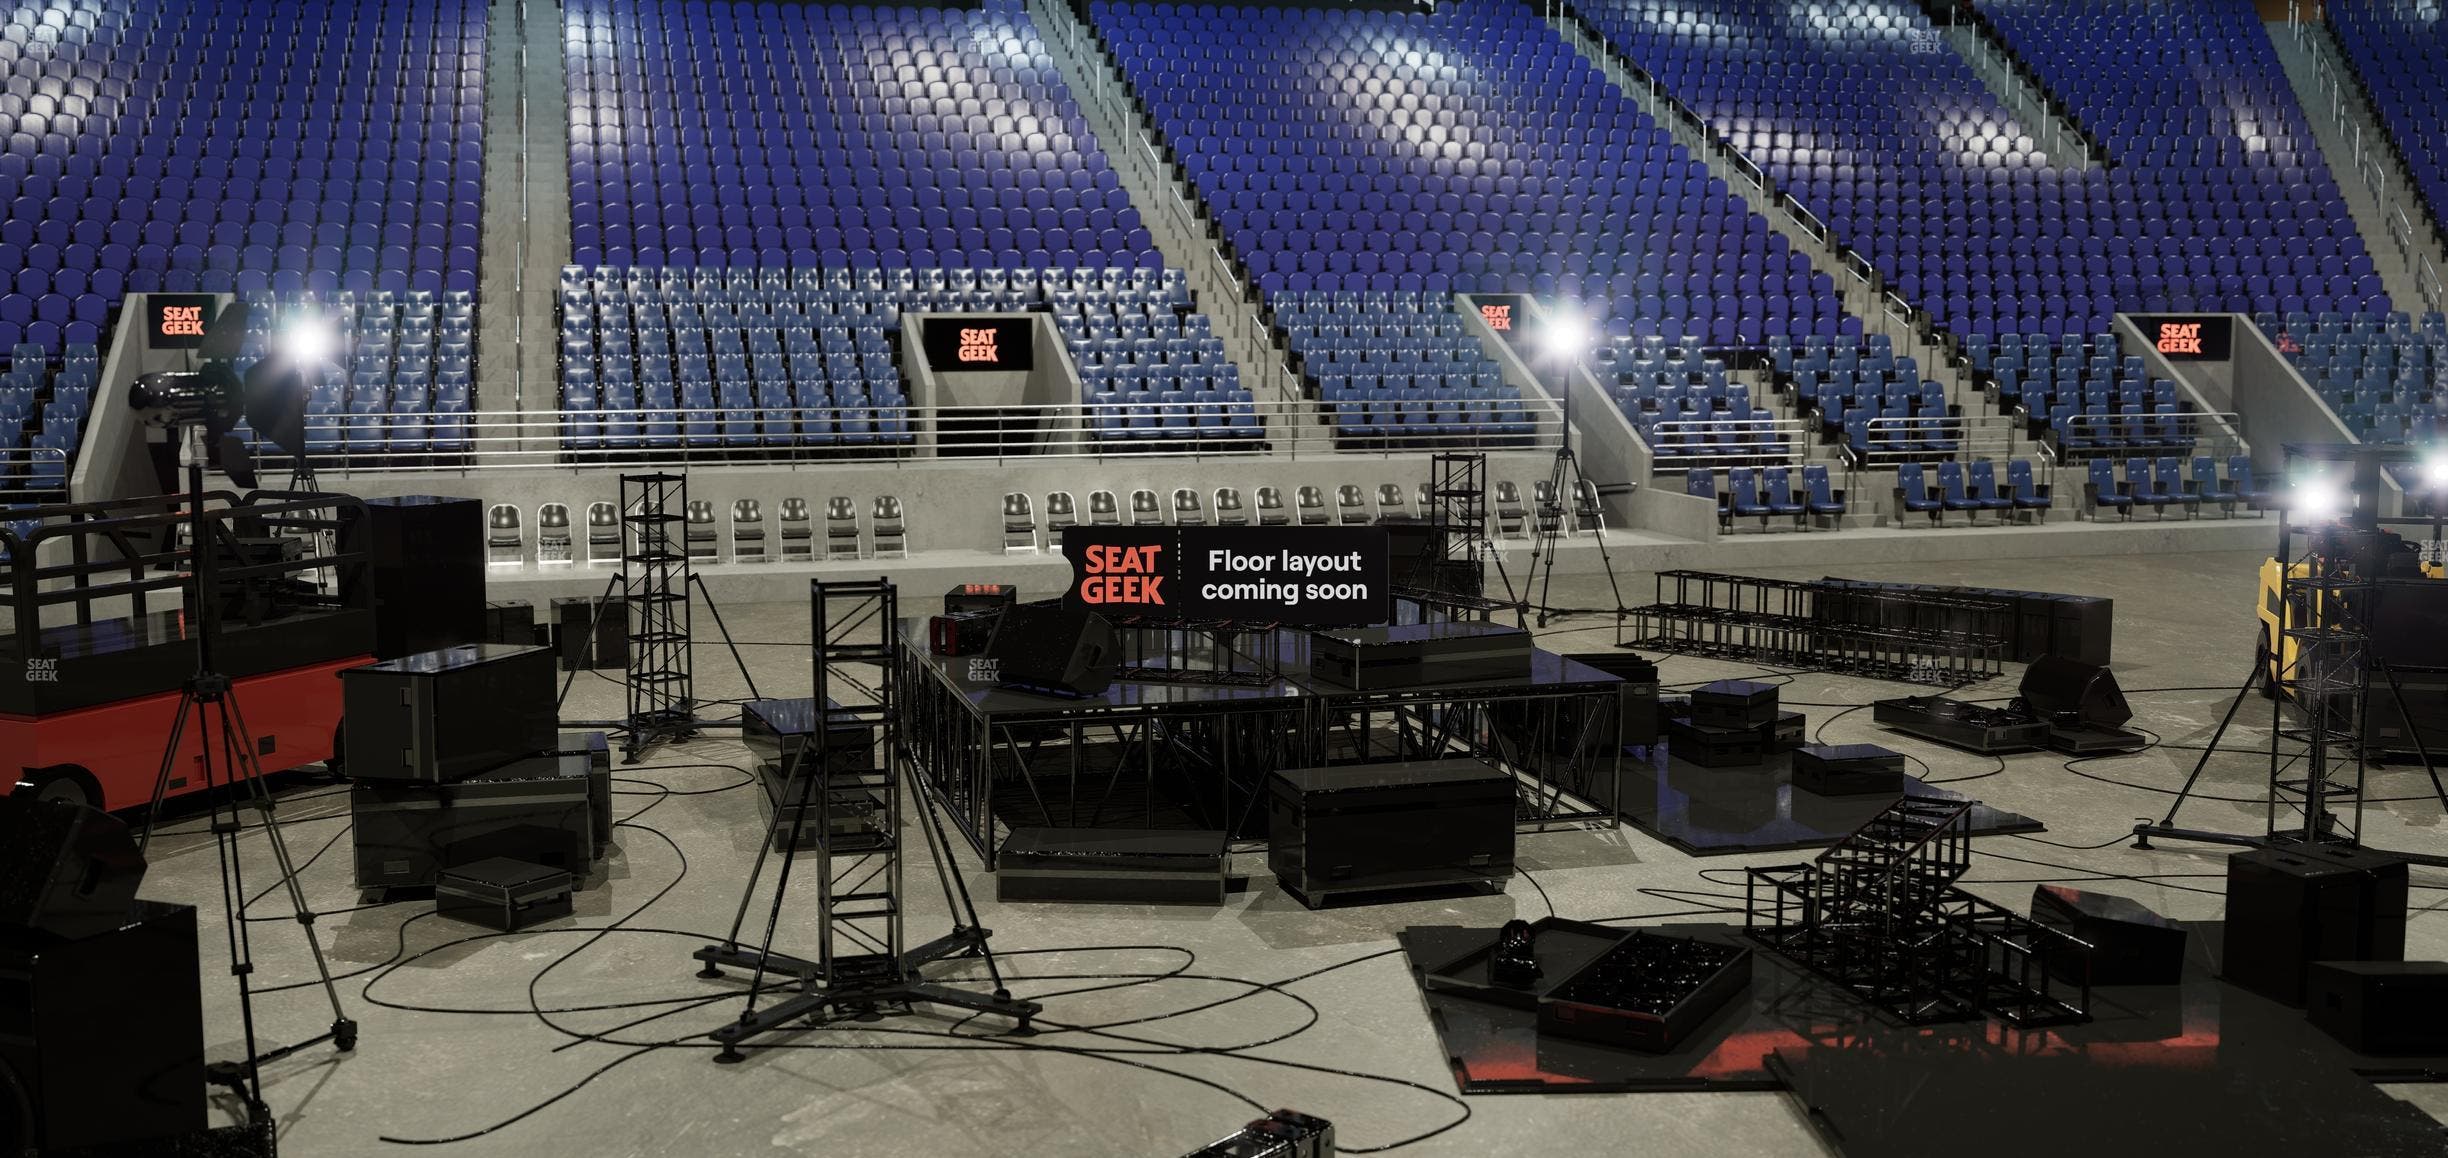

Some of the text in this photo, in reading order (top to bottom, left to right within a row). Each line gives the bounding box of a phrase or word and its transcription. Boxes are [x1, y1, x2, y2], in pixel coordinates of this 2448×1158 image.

[163, 306, 202, 320] SEAT
[1481, 305, 1511, 318] SEAT
[161, 321, 205, 335] GEEK
[1487, 318, 1511, 330] EEK
[2160, 323, 2201, 338] SEAT
[960, 328, 997, 345] SEAT
[958, 345, 999, 362] GEEK
[2157, 338, 2202, 354] GEEK
[1085, 544, 1162, 573] SEAT
[1209, 549, 1362, 577] Floor layout
[1080, 576, 1165, 605] GEEK
[1201, 578, 1368, 605] coming soon
